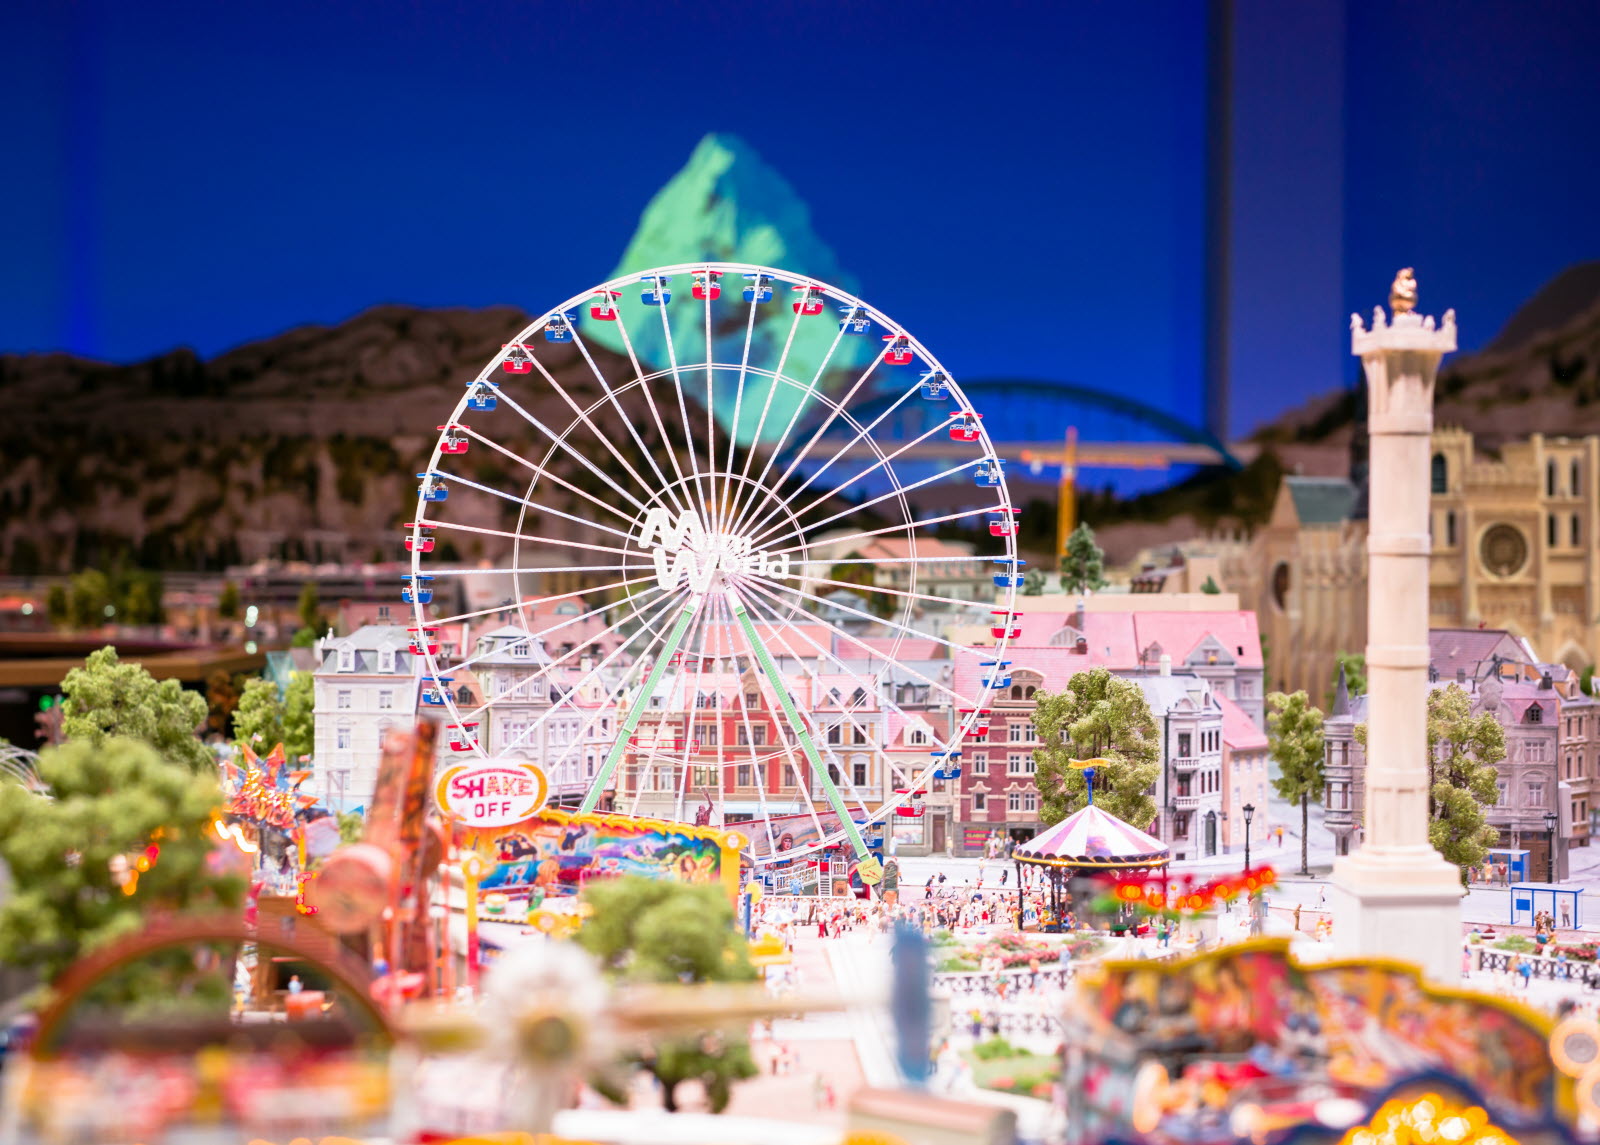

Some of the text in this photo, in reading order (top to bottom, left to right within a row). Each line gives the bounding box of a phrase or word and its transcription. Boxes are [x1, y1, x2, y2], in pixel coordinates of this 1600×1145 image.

[653, 547, 790, 594] World
[452, 768, 533, 799] SHAKE
[474, 801, 511, 818] OFF
